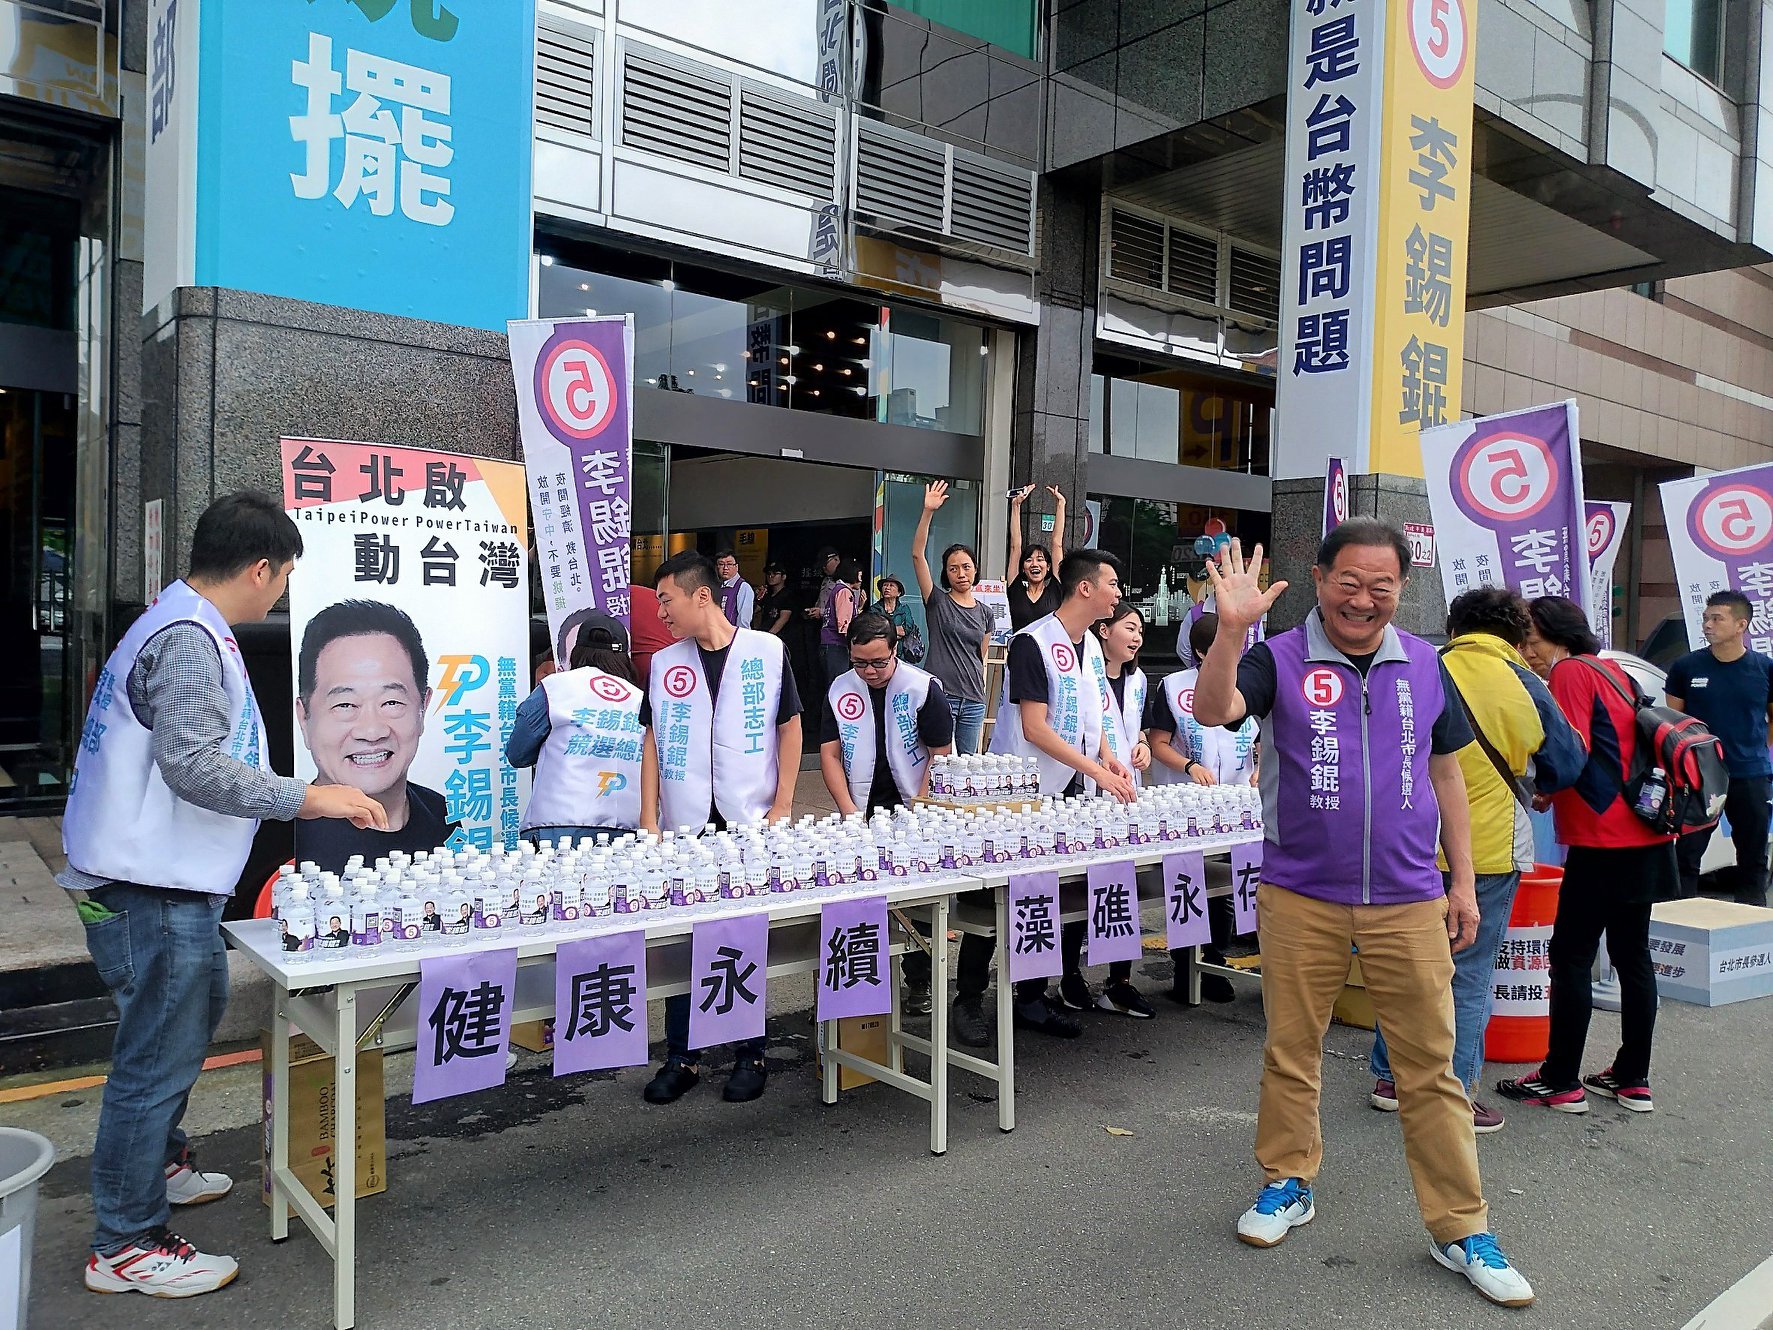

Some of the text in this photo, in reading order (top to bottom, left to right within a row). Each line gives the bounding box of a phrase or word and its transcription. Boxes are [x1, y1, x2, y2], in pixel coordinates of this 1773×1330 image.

[288, 0, 455, 226] 擺
[1399, 114, 1458, 430] 李錫錕
[416, 515, 518, 534] PowerTaiwan
[353, 532, 520, 589] 動台灣
[673, 671, 687, 692] 5
[1056, 648, 1068, 667] 5
[740, 657, 766, 754] 總部志工
[844, 698, 858, 716] 5
[1062, 675, 1078, 734] 李錫錕
[1314, 674, 1331, 703] 5
[666, 701, 692, 768] 李錫錕
[1310, 709, 1340, 793] 李錫錕
[1310, 794, 1340, 811] 教授
[429, 980, 506, 1067] 健
[565, 963, 636, 1041] 康
[699, 946, 759, 1014] 永
[824, 922, 882, 992] 續
[1014, 894, 1056, 954] 藻
[1092, 883, 1134, 939] 礁
[1170, 872, 1203, 925] 永
[1490, 985, 1551, 1000] 長請投
[319, 1086, 329, 1140] BAMBOO
